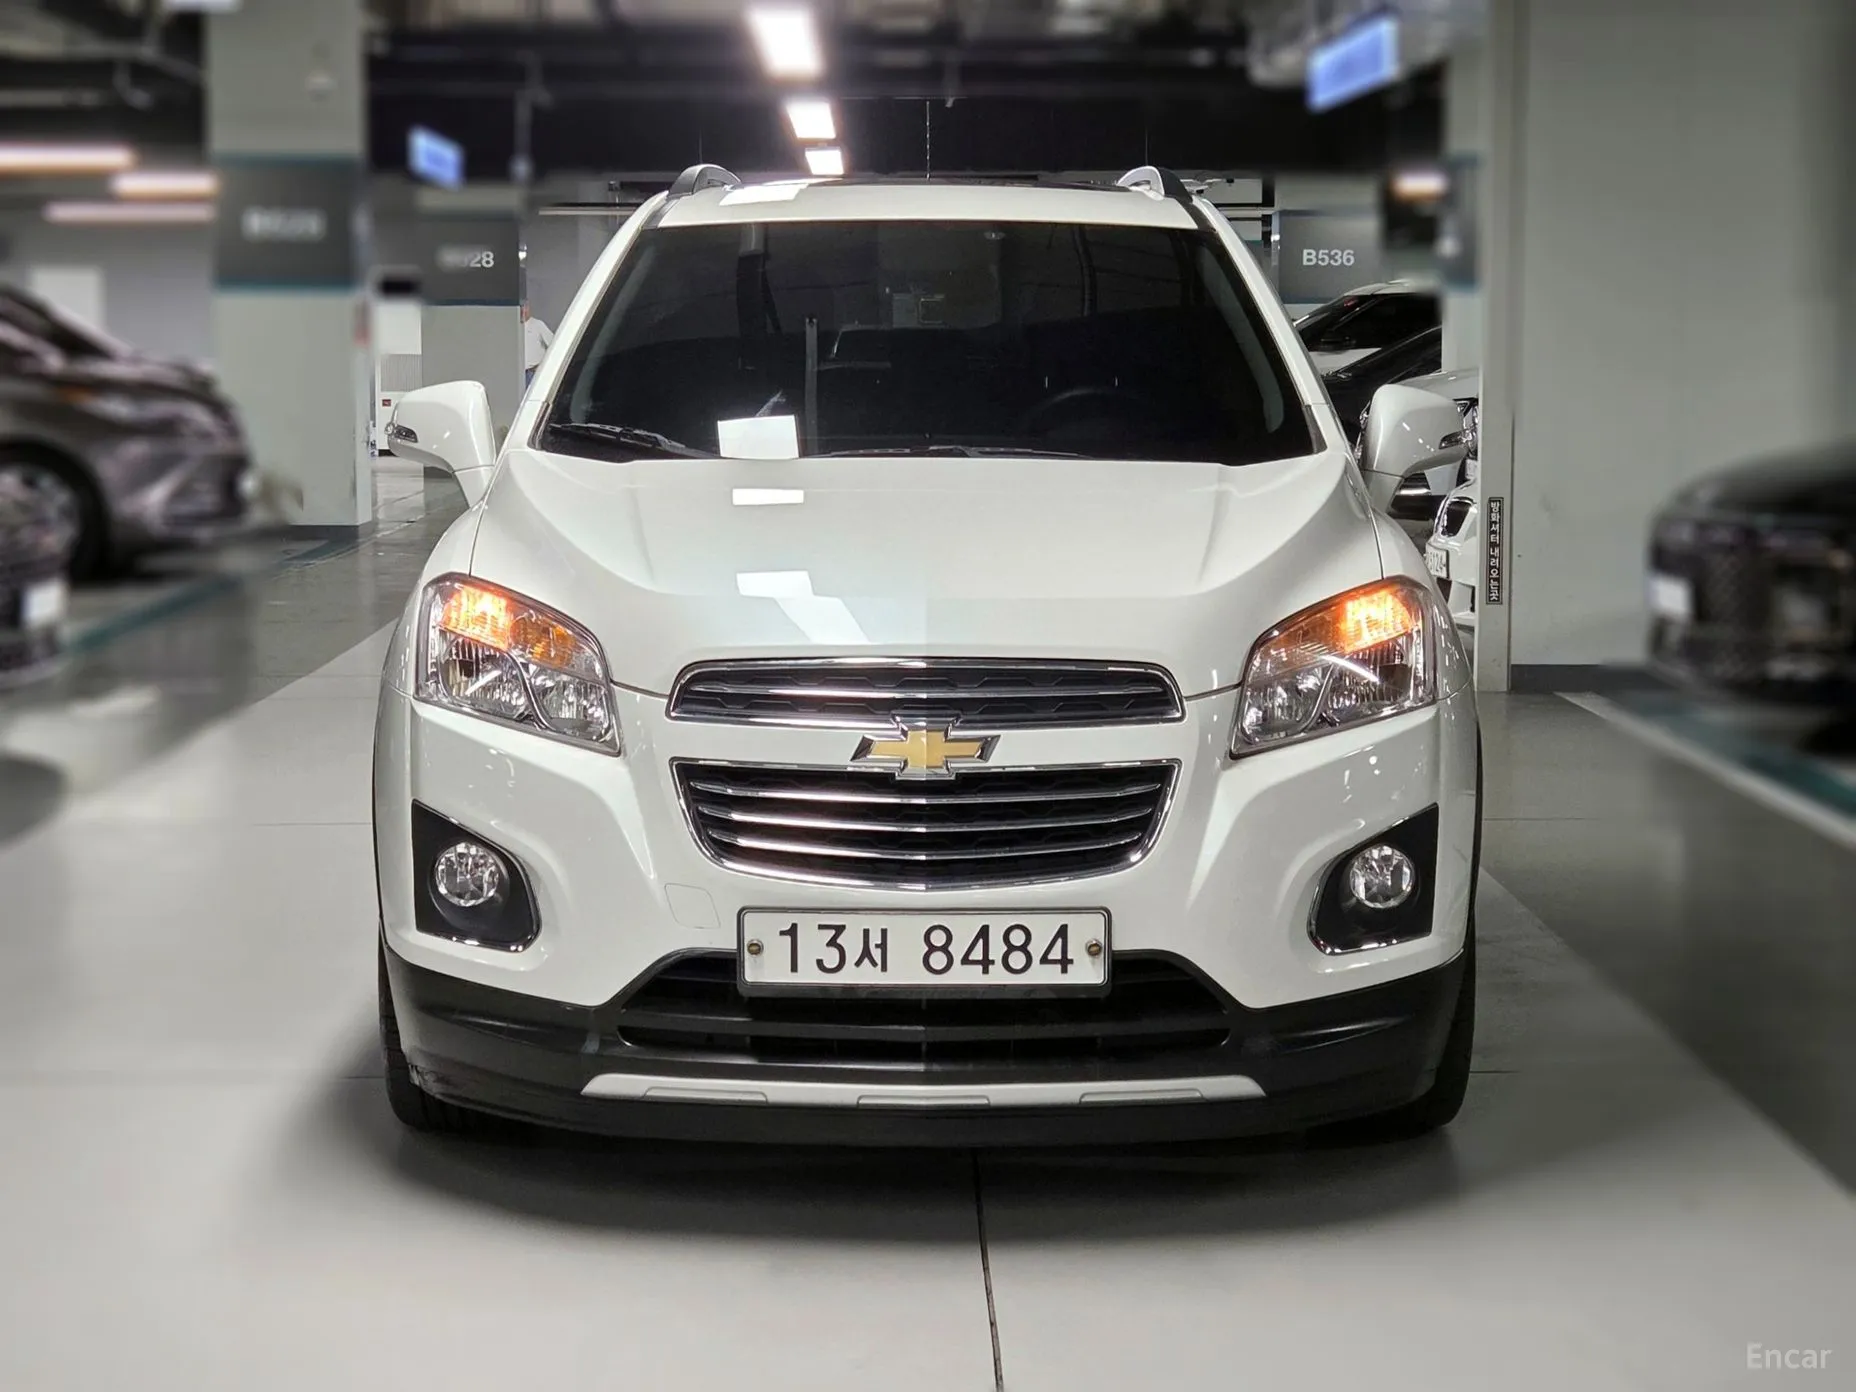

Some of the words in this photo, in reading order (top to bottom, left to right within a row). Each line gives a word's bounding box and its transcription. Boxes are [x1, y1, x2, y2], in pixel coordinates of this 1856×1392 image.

[1302, 248, 1355, 266] B536
[779, 922, 888, 974] 13서
[922, 923, 1075, 975] 8484
